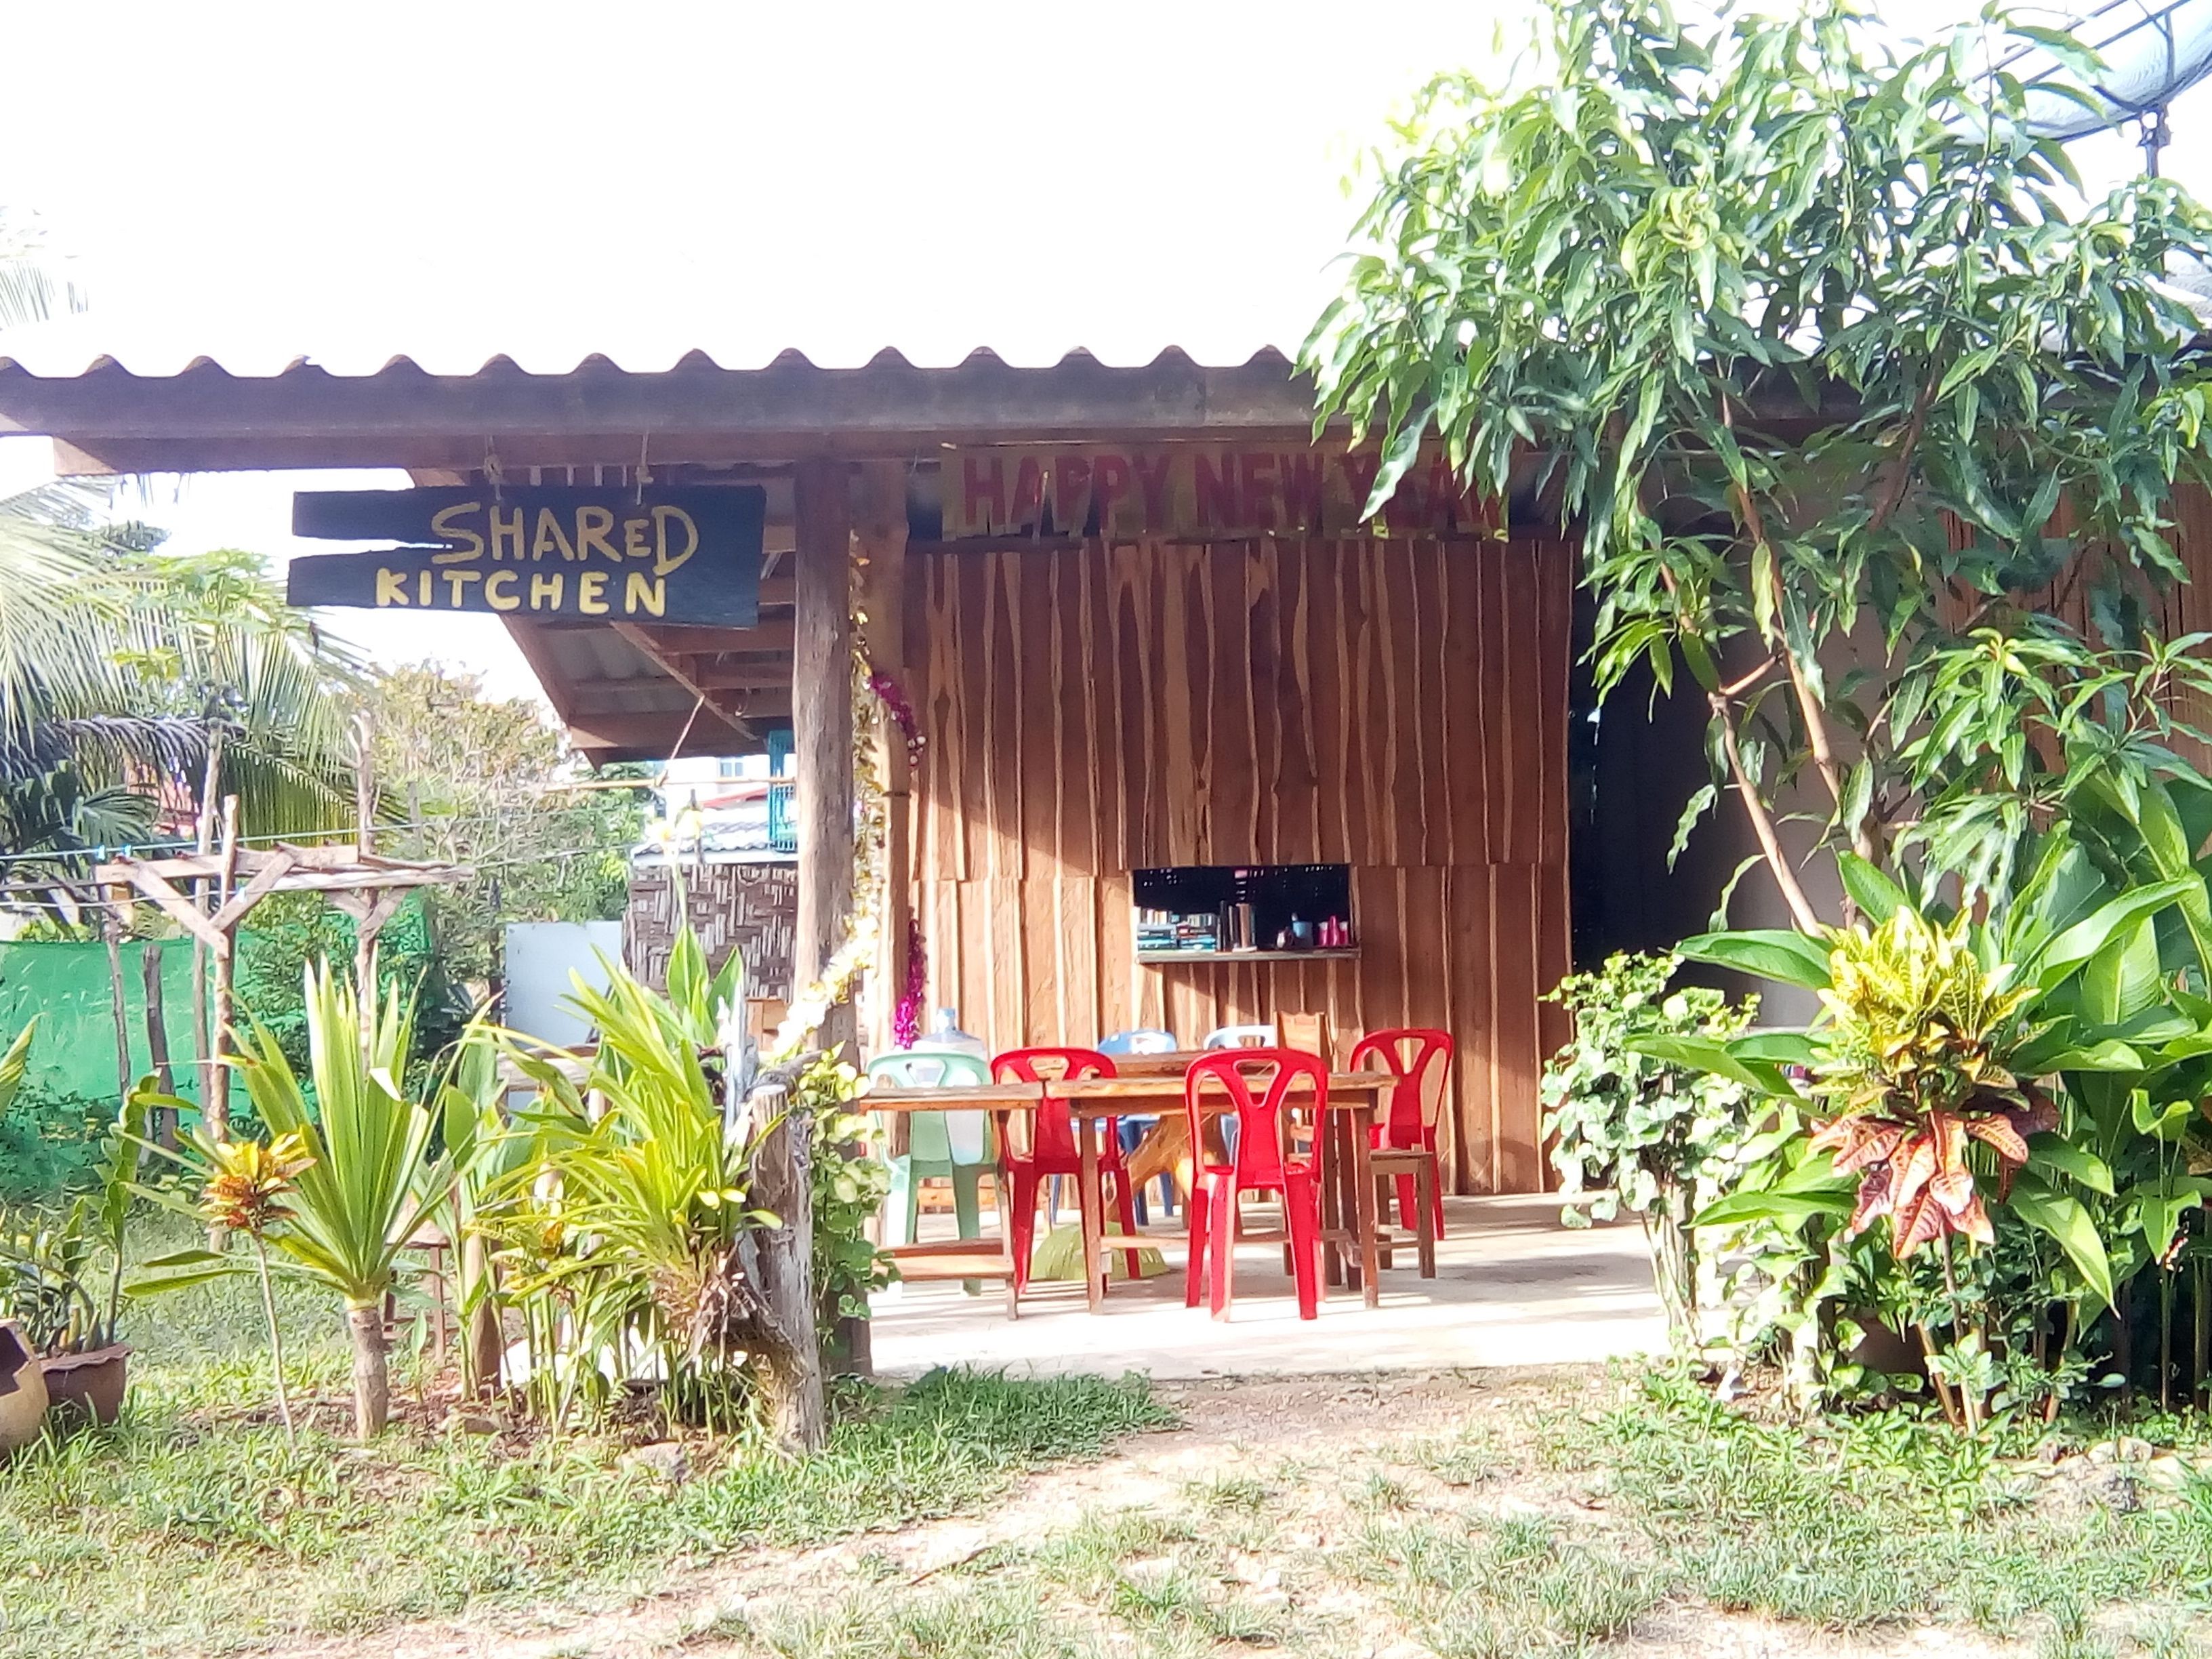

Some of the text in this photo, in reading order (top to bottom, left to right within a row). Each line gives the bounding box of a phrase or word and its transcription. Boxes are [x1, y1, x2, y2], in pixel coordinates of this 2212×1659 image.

[963, 453, 1175, 531] HAPPY
[1195, 452, 1324, 529] NEW
[431, 501, 699, 576] SHARED
[375, 567, 667, 617] KITCHEN
